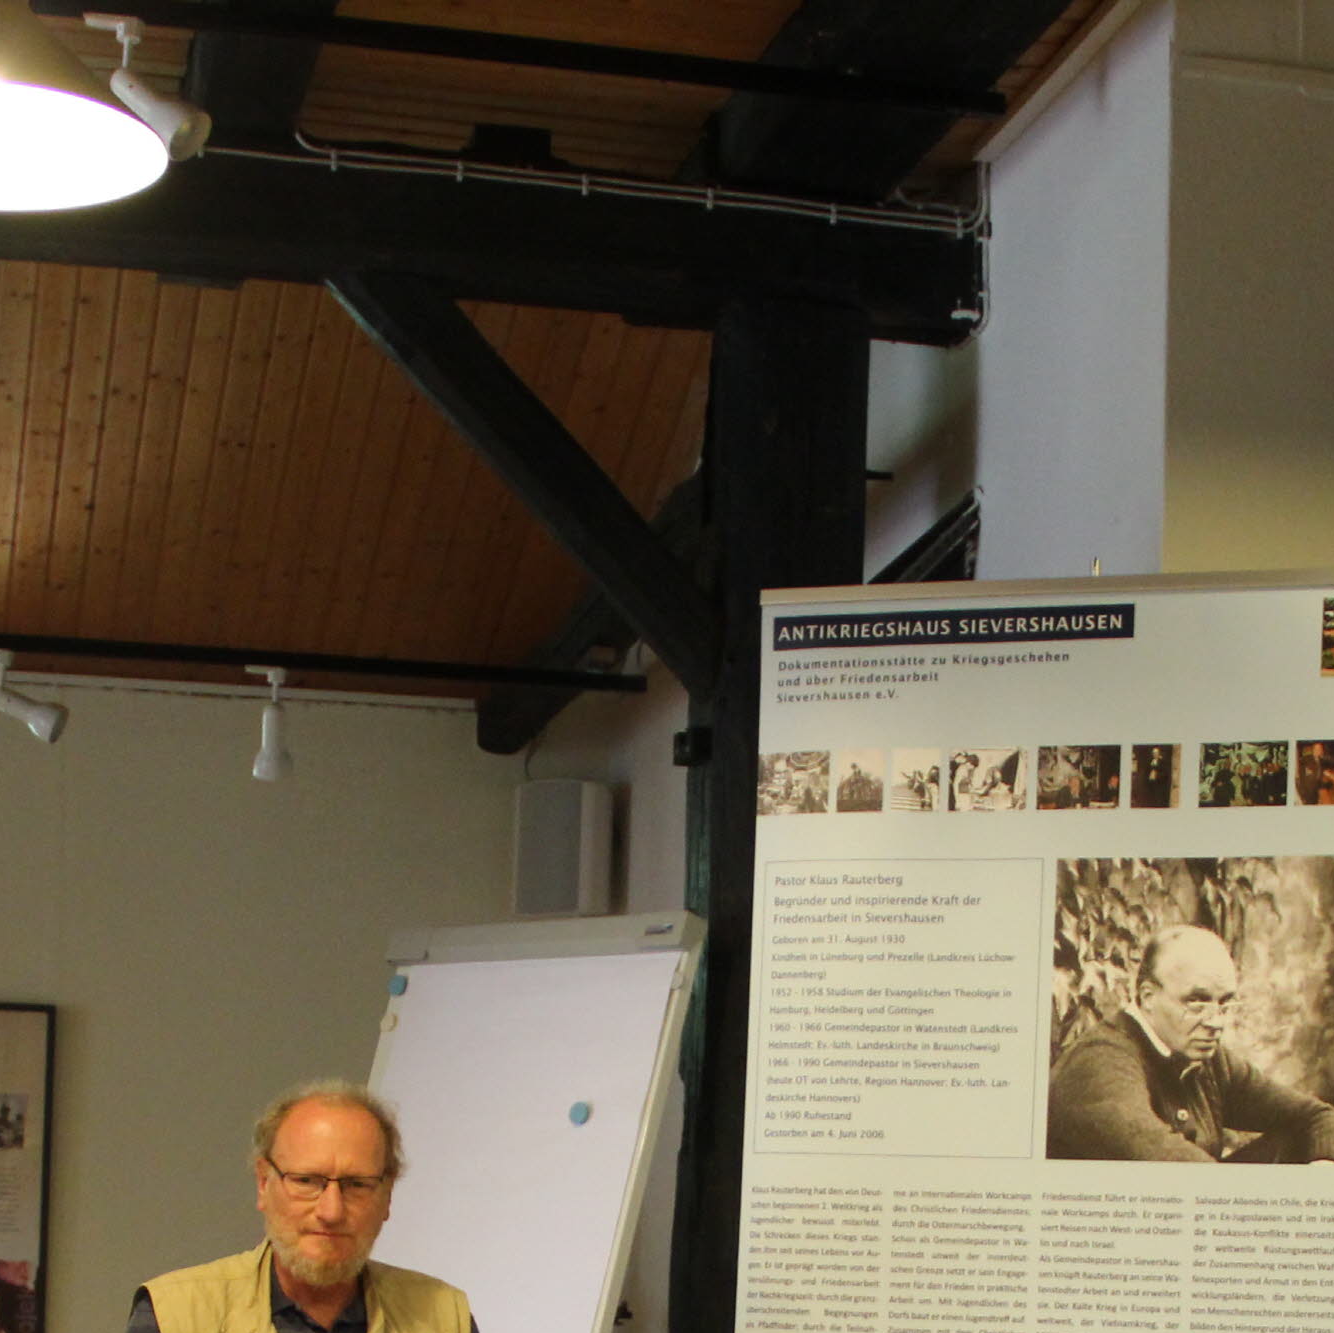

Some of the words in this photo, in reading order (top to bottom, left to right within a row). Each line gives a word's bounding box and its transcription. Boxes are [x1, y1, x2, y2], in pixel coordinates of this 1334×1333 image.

[778, 620, 952, 641] ANTIKRIEGSHAUS
[959, 614, 1123, 635] SIEVERSHAUSEN
[778, 656, 925, 671] Dokumentationsstätte
[931, 658, 947, 666] zu
[953, 652, 1070, 668] Kriegsgeschehen
[778, 676, 800, 687] und
[806, 675, 835, 686] über
[841, 672, 939, 685] Friedensarbeit
[777, 690, 869, 703] Sievershausen
[876, 689, 899, 700] e.V.
[775, 876, 806, 886] Pastor
[810, 875, 838, 886] Klaus
[842, 874, 903, 888] Rauterberg
[774, 896, 826, 908] Begründer
[831, 896, 851, 906] und
[856, 895, 927, 908] inspirierende
[932, 895, 959, 905] Kraft
[962, 895, 981, 905] der
[774, 913, 847, 923] Friedensarbeit
[851, 913, 861, 923] in
[866, 913, 944, 923] Sievershausen
